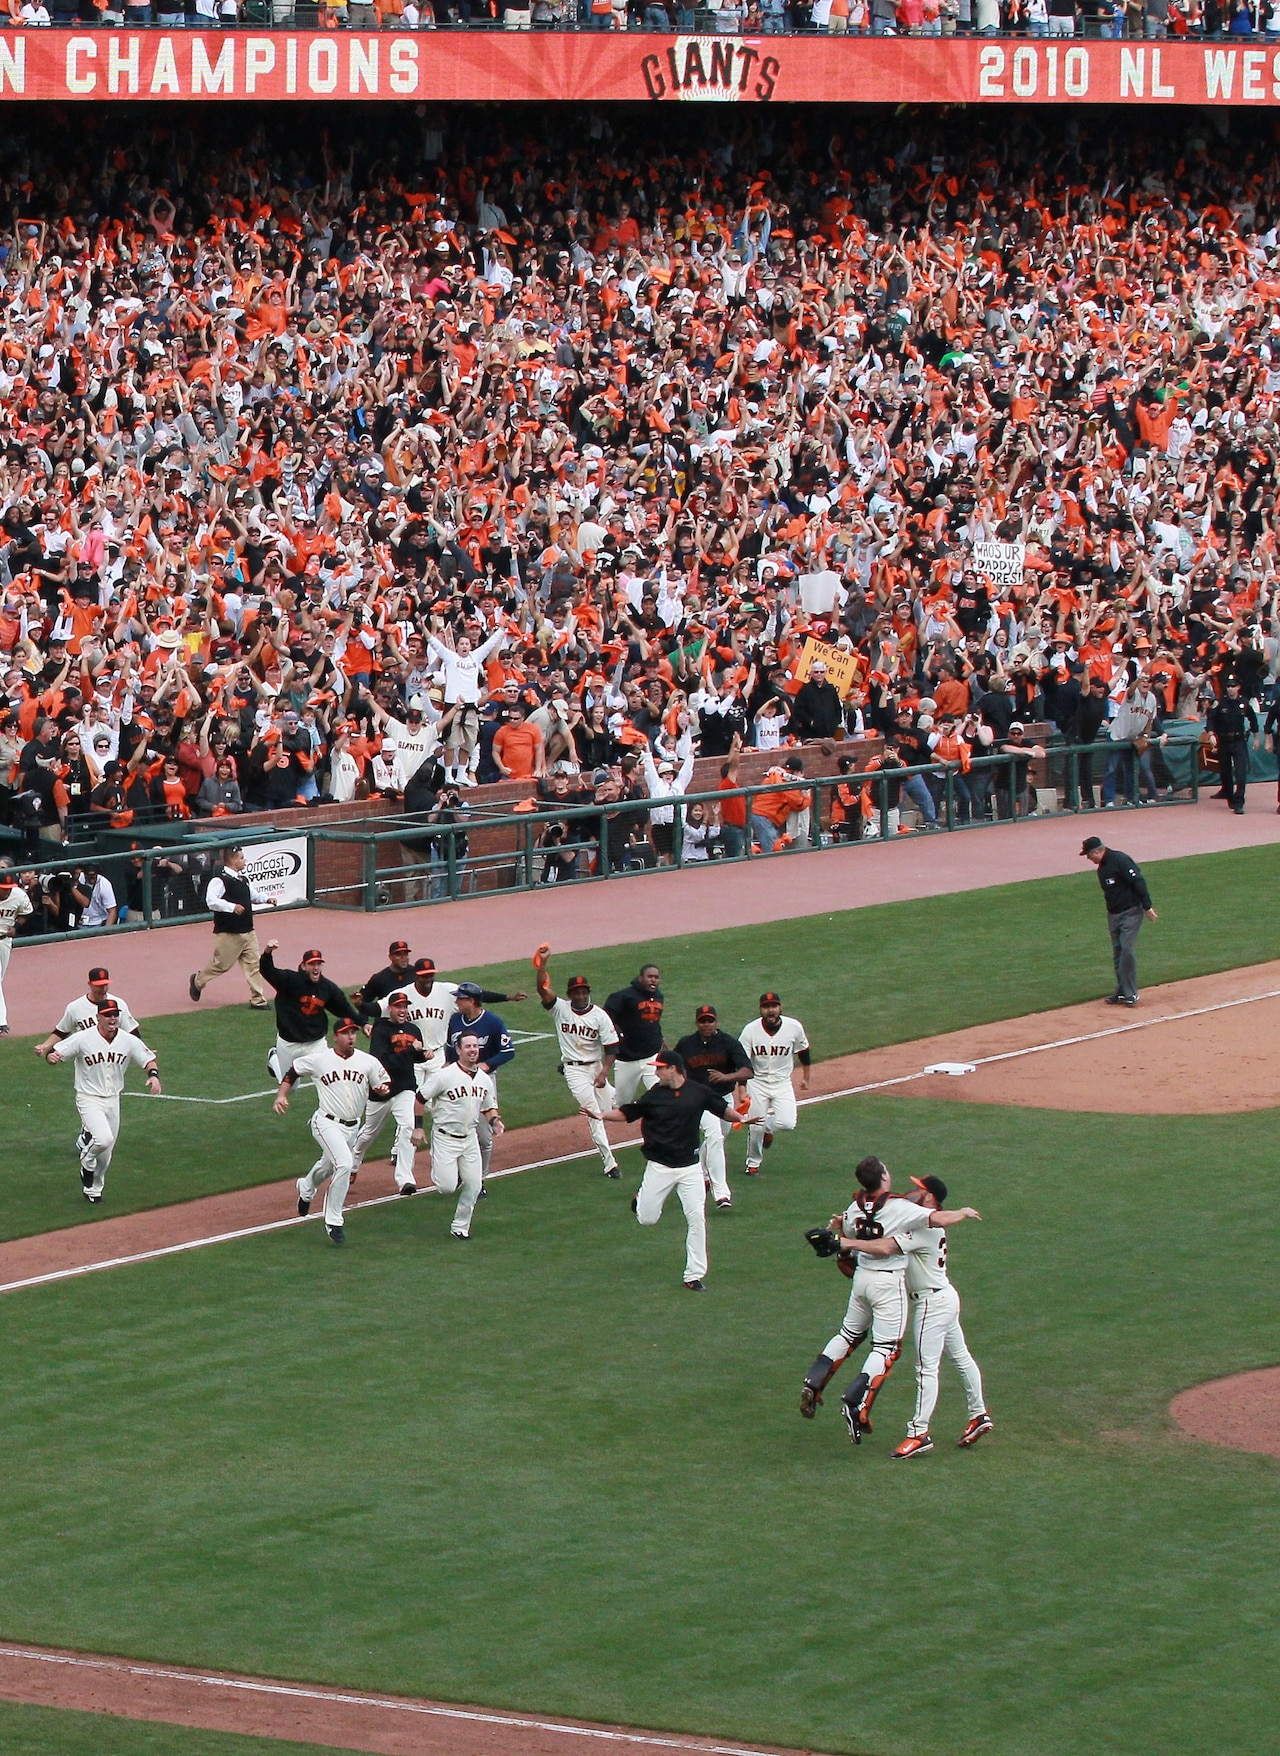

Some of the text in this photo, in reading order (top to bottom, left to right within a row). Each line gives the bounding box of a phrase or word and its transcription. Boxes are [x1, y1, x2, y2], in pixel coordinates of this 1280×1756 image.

[66, 37, 419, 94] CHAMPIONS
[641, 41, 781, 100] GIANTS
[980, 46, 1089, 97] 2010
[1120, 48, 1175, 98] NL
[976, 544, 1020, 561] WHO'S UR
[977, 559, 1021, 574] DADDY?
[976, 570, 1022, 585] DRES!
[814, 642, 849, 665] We Can
[809, 656, 845, 680] Mke It
[398, 741, 424, 752] GIANTS
[248, 867, 289, 882] SPORTSNET
[255, 883, 285, 893] UTHENTIC
[407, 1008, 444, 1022] GIANTS
[77, 1017, 96, 1030] GIA
[561, 1023, 599, 1039] GIANTS
[320, 1069, 365, 1086] GIANTS
[447, 1085, 488, 1101] GIANTS
